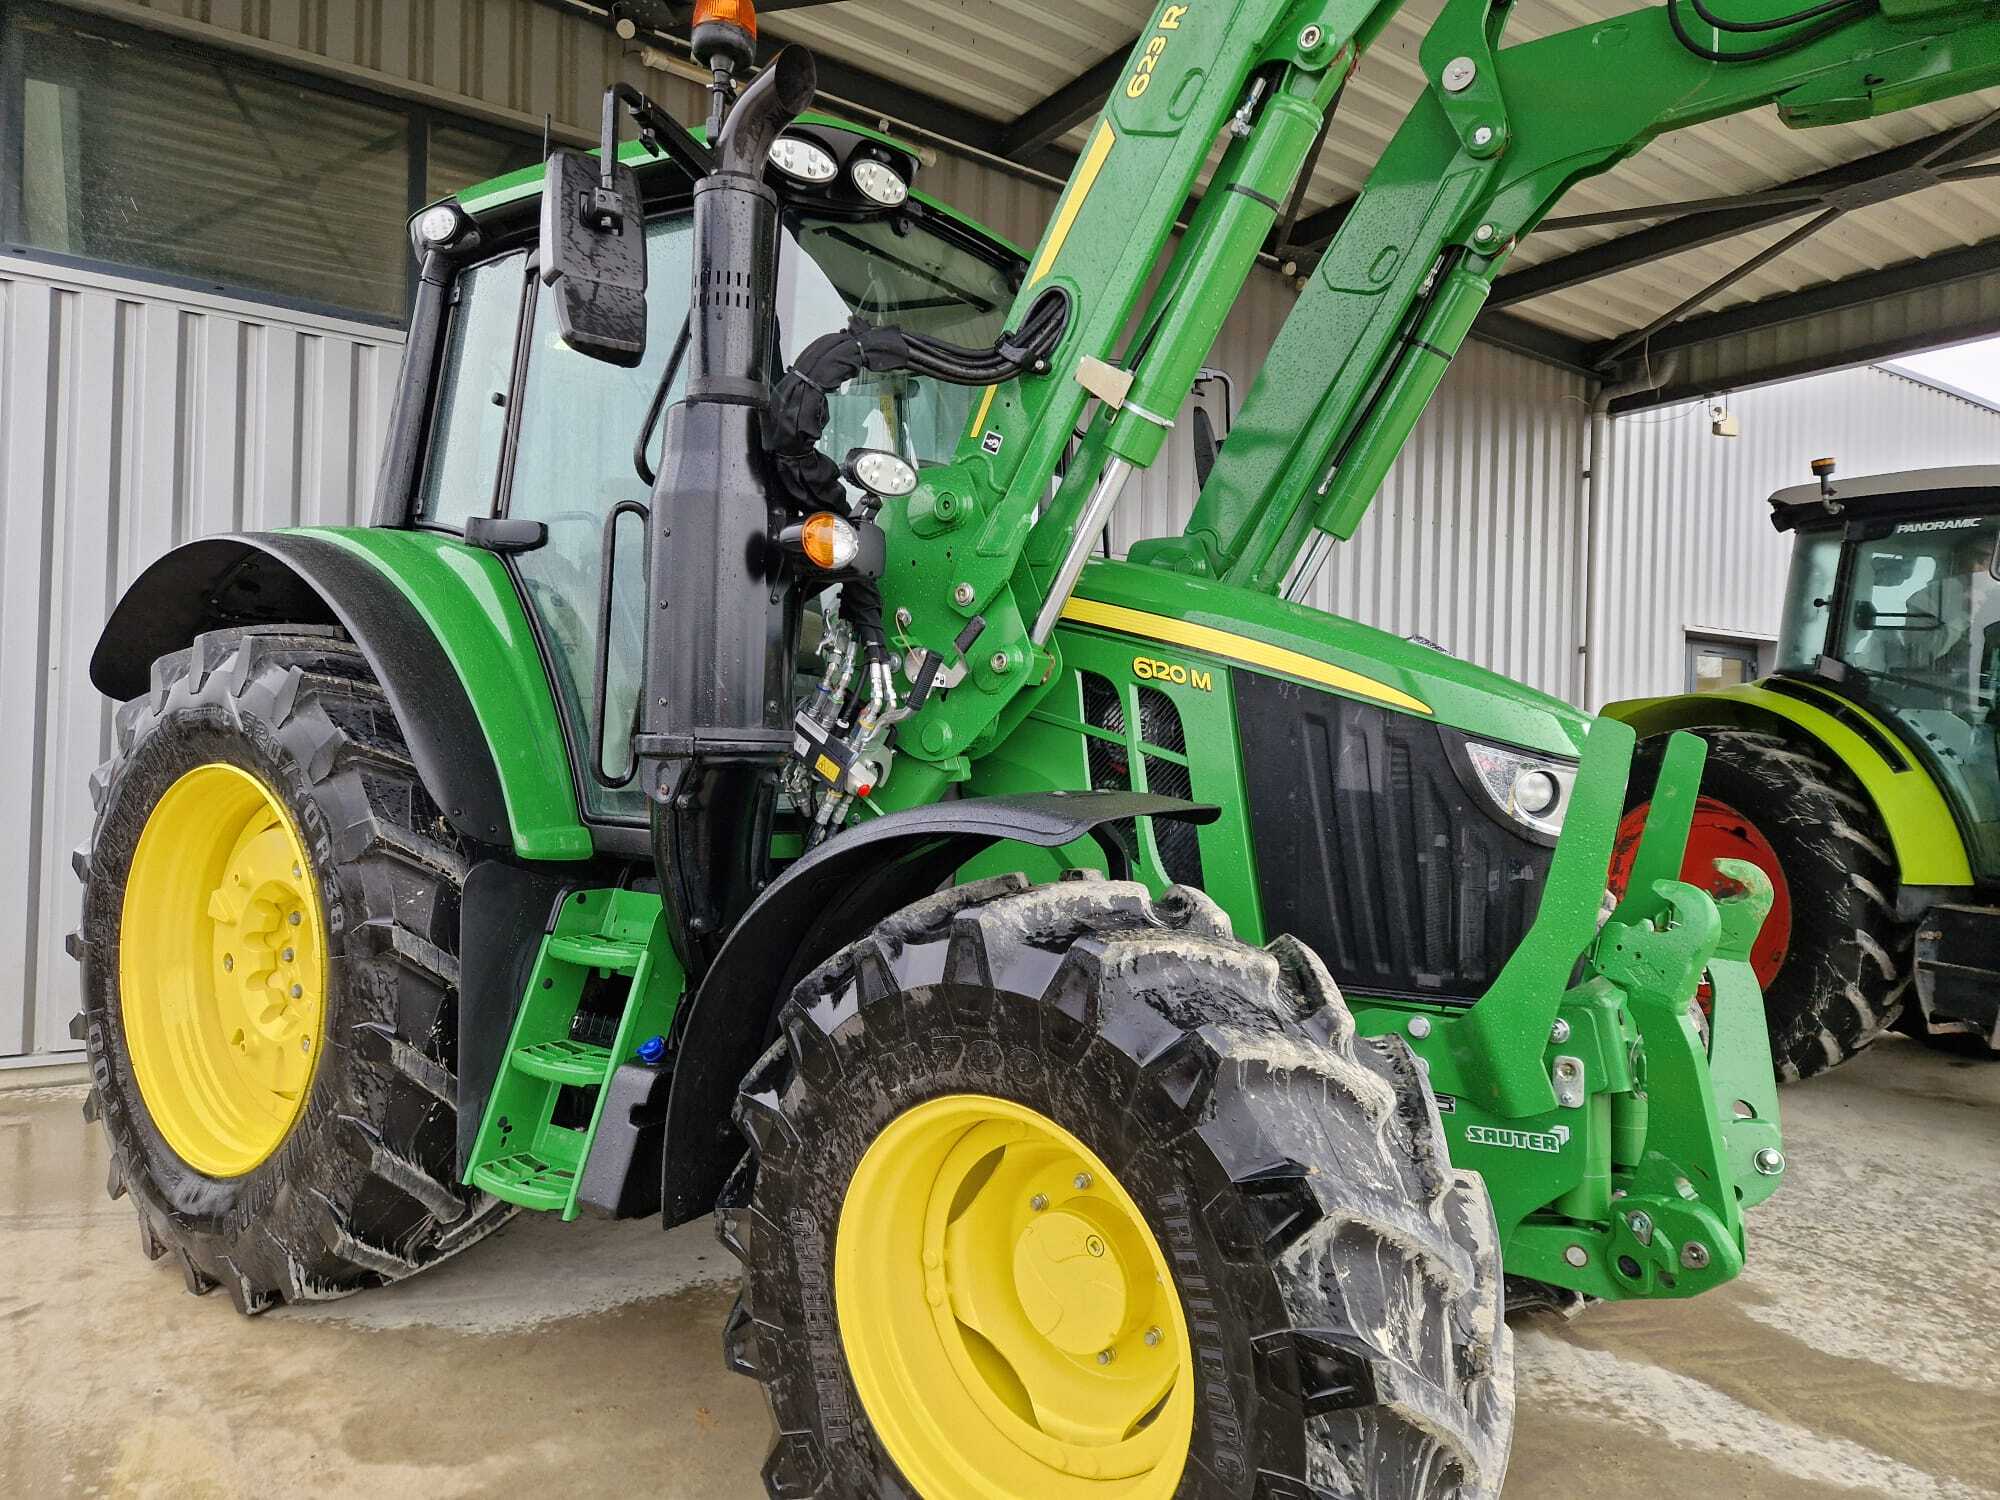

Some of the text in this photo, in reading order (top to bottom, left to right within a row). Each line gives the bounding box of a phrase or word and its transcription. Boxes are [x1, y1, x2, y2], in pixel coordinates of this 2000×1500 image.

[1126, 4, 1190, 98] 623 R
[1896, 517, 1984, 534] PANORAMIC
[1132, 656, 1213, 693] 6120 M
[1465, 1125, 1560, 1153] SAUTER
